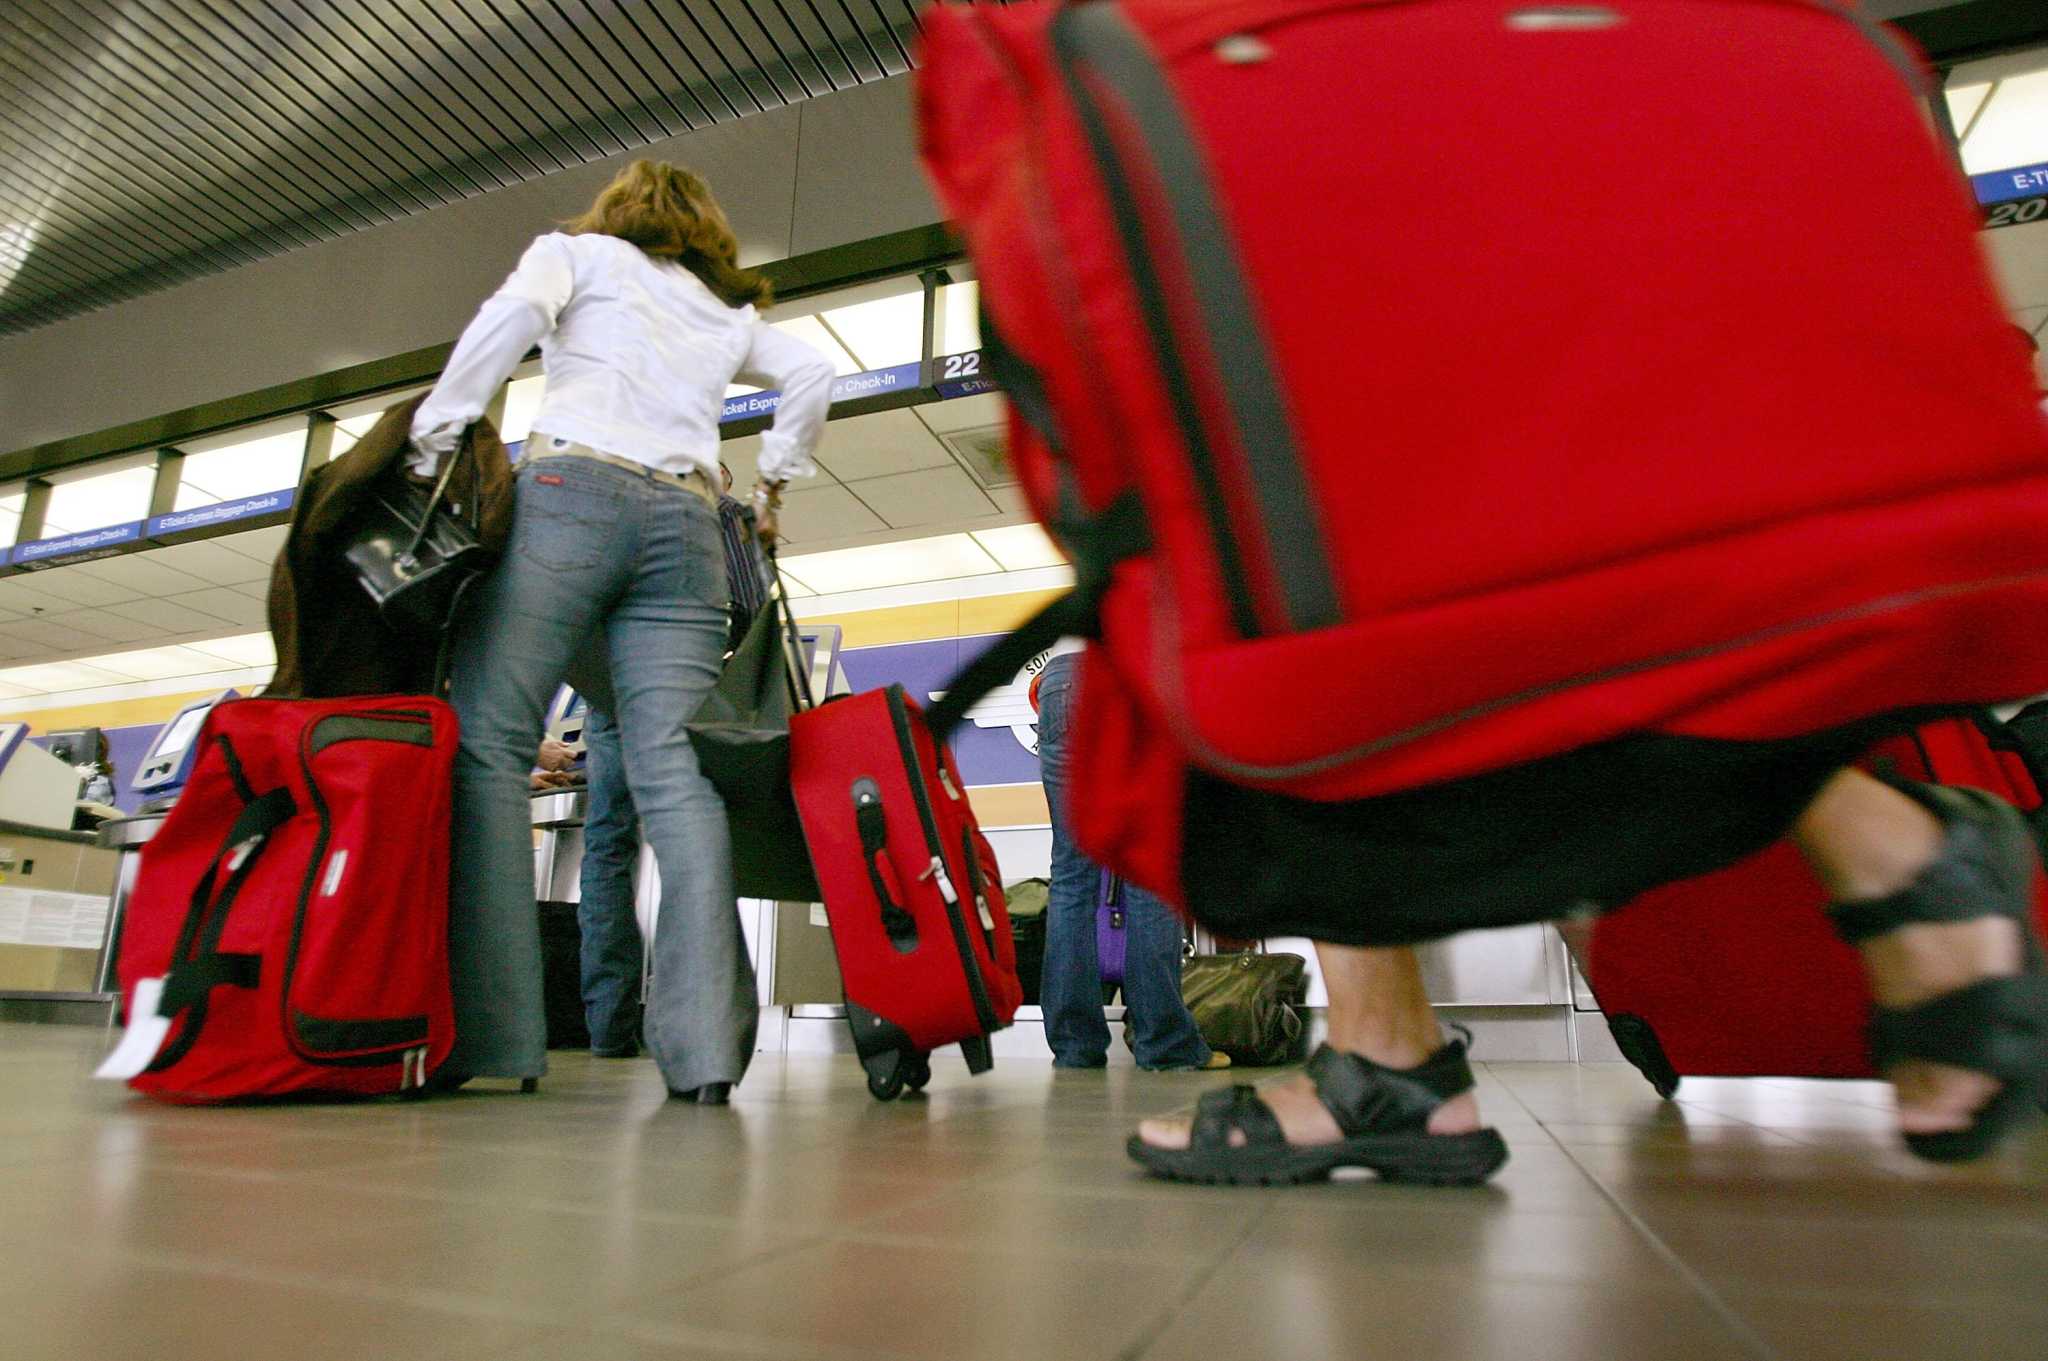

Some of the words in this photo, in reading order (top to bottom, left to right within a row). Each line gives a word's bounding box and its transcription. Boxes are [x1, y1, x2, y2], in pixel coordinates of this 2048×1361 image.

[1985, 198, 2048, 226] 20
[944, 352, 980, 379] 22
[722, 402, 748, 417] icket
[749, 395, 784, 412] Expre
[846, 373, 896, 392] Check-In
